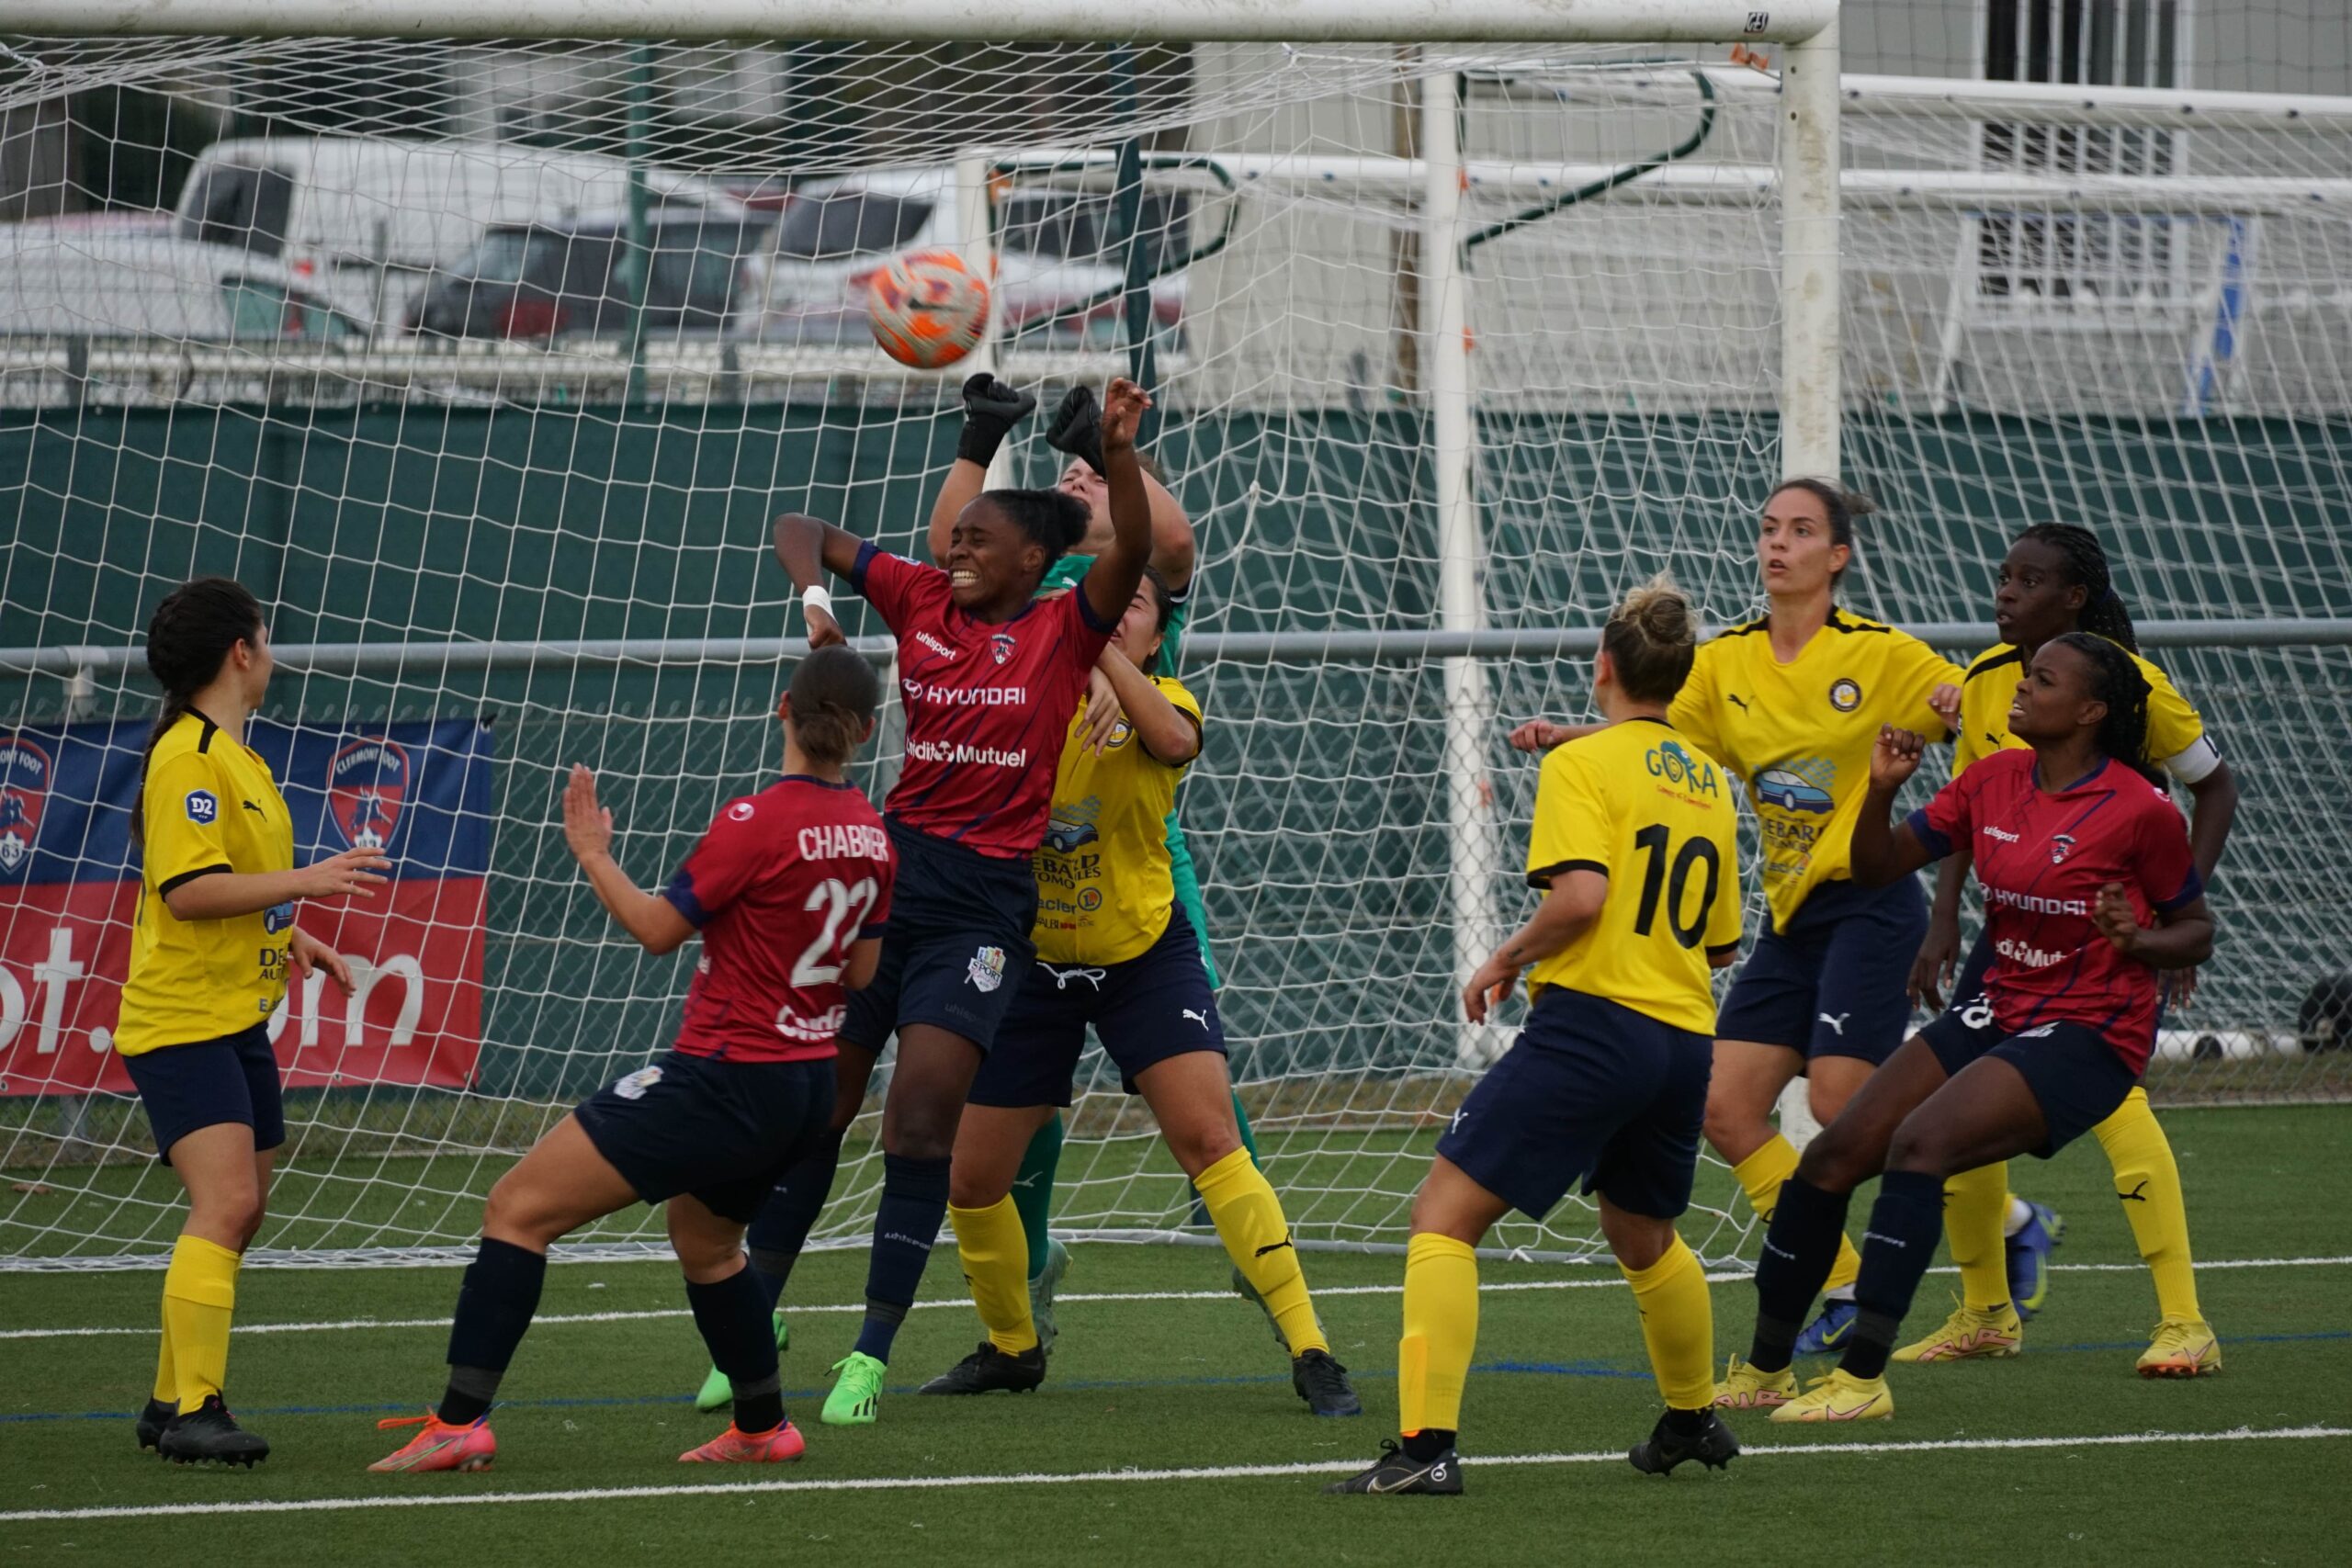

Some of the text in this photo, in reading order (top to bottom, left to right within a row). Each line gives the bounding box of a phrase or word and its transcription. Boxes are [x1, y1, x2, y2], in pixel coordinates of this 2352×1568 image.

[915, 631, 956, 660] uhlsport
[926, 685, 1026, 705] HYUNDAI
[378, 751, 401, 772] OOT
[956, 744, 1026, 767] Mutuel
[1645, 747, 1718, 798] GOKA
[190, 797, 213, 815] D2
[1634, 823, 1720, 950] 10
[1995, 888, 2087, 916] HYUNDAI
[791, 877, 878, 987] 22
[972, 961, 1001, 983] SPORT
